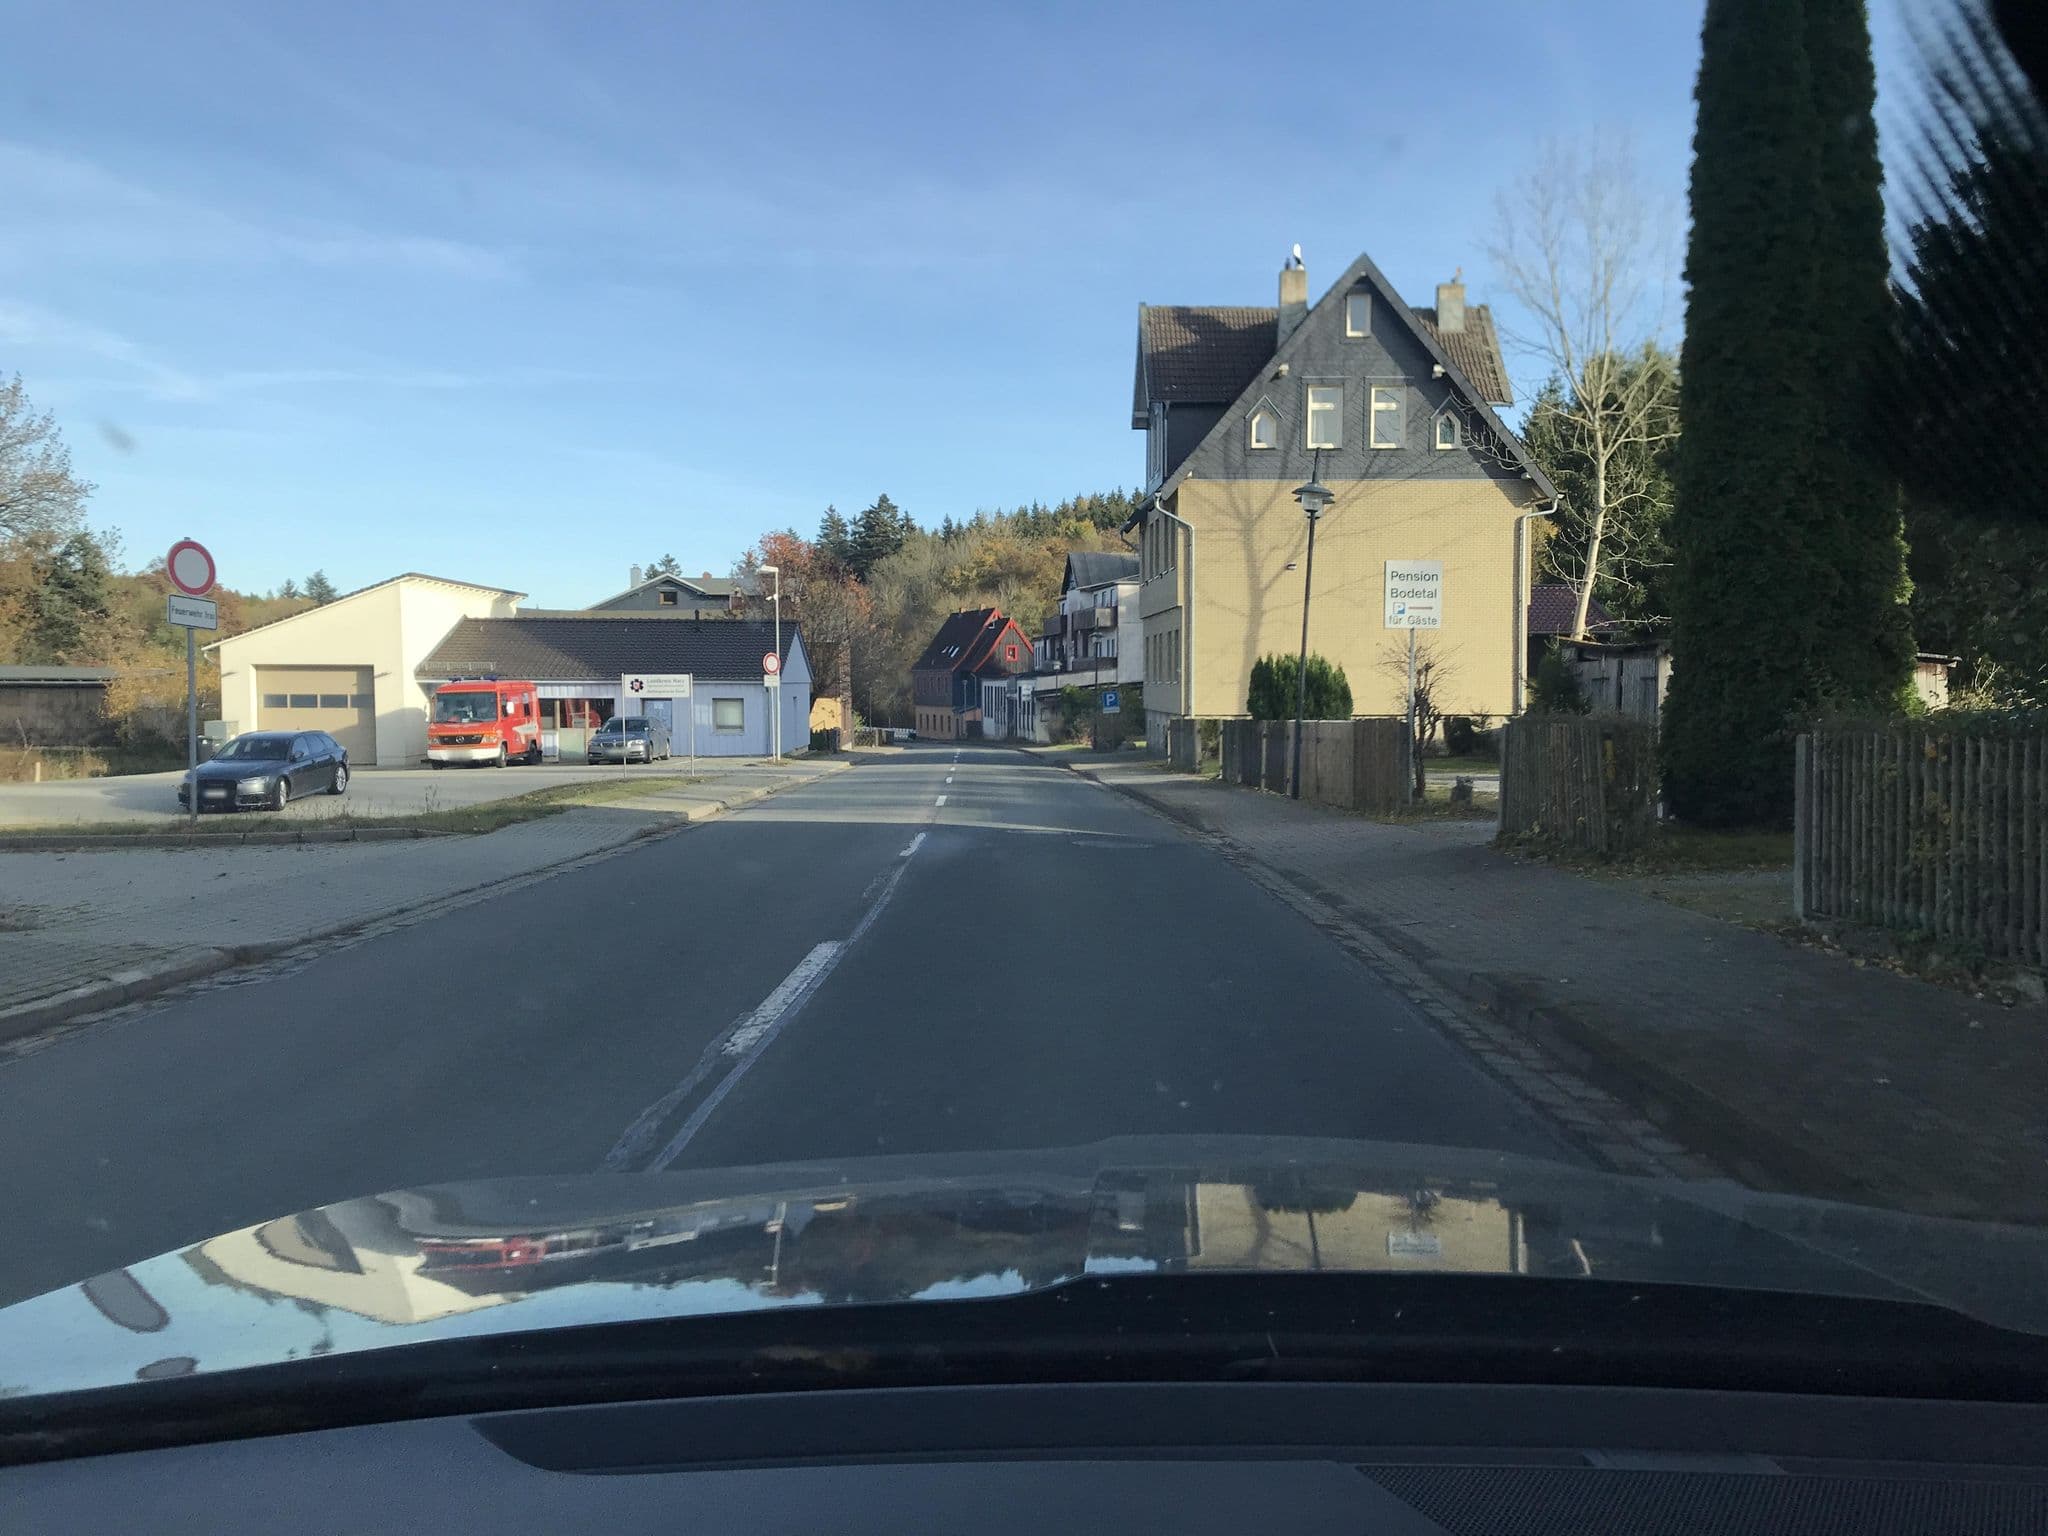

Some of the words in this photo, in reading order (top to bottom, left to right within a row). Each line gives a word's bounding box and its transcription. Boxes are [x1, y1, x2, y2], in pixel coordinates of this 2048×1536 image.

[1391, 570, 1439, 581] Pension
[1391, 588, 1437, 598] Bodetal
[1389, 615, 1402, 625] für
[1408, 615, 1438, 625] Gäste
[1106, 693, 1115, 706] P
